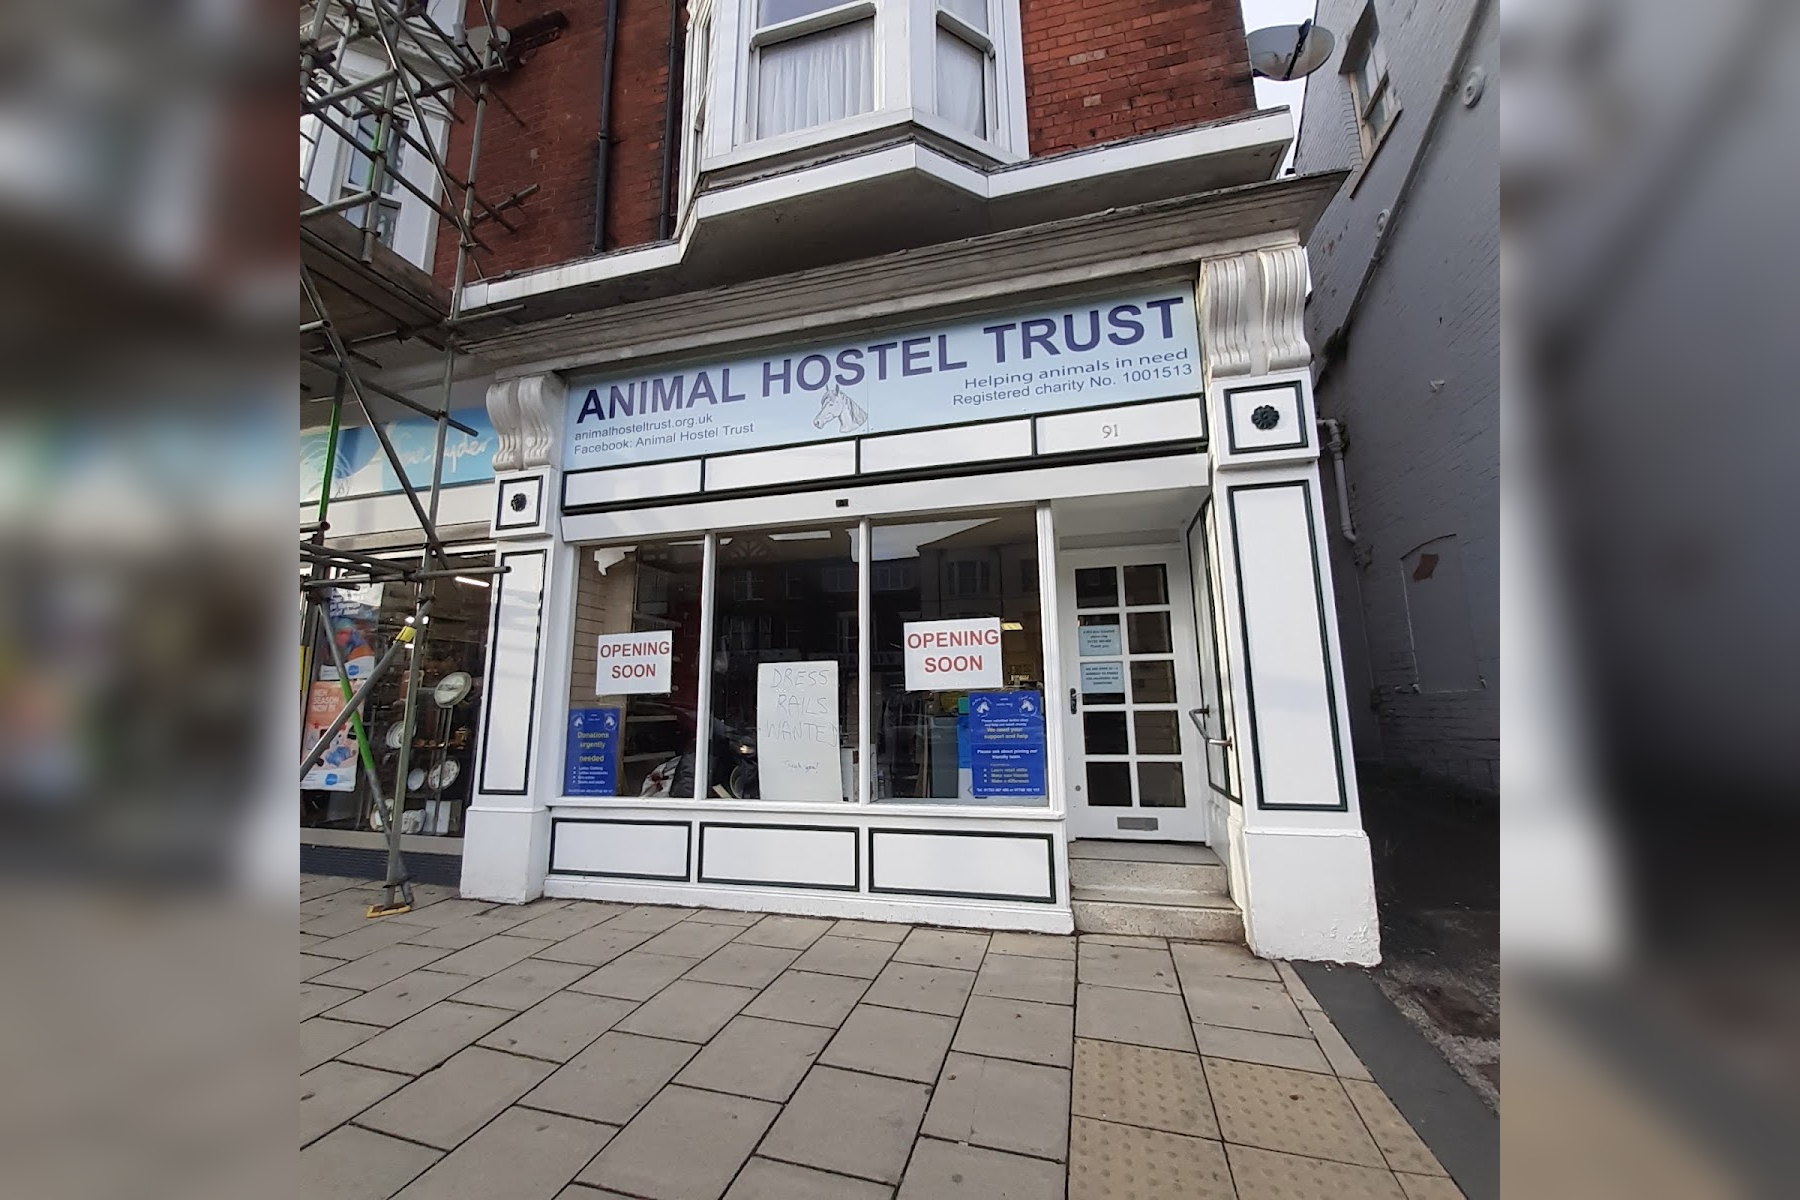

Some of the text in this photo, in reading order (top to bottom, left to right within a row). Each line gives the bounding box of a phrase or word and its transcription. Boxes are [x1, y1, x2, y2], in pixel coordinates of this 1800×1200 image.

[576, 297, 1184, 424] ANIMAL HOSTEL TRUST
[964, 348, 1189, 389] Helping animals in need
[953, 363, 1193, 406] Registered charity No. 1001513
[574, 413, 713, 441] animalhosteltrust.org.uk
[1101, 423, 1120, 439] 91
[574, 422, 755, 455] Facebook: Animal Hostel Trust
[906, 629, 1000, 649] OPENING
[600, 641, 670, 658] OPENING
[611, 663, 657, 679] SOON
[924, 655, 984, 673] SOON
[769, 667, 829, 688] DRESS
[777, 693, 829, 716] RAILS
[577, 731, 610, 739] Donations
[766, 719, 838, 748] WANTED
[580, 741, 606, 750] urgently
[579, 755, 605, 763] needed
